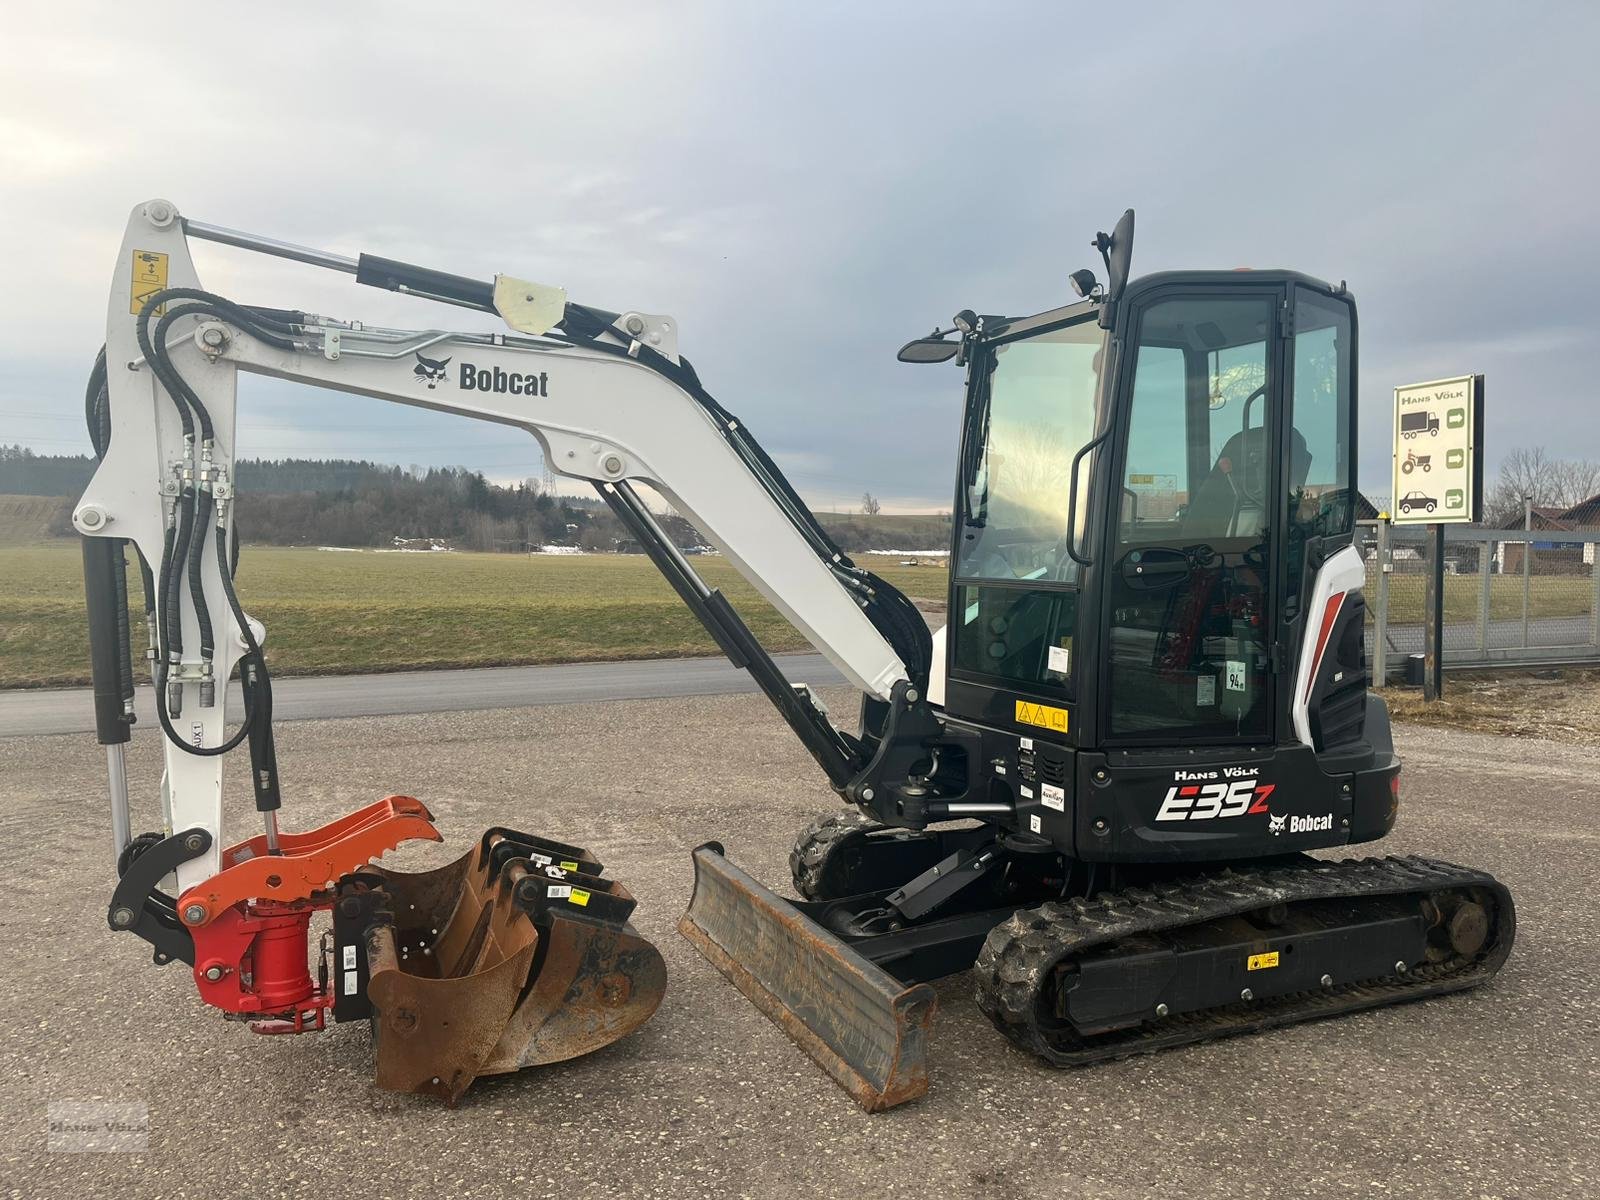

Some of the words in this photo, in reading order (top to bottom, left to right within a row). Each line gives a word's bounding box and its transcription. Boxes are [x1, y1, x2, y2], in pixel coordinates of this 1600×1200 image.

[459, 363, 548, 397] Bobcat
[1230, 673, 1239, 689] 94
[1289, 813, 1333, 833] Bobcat
